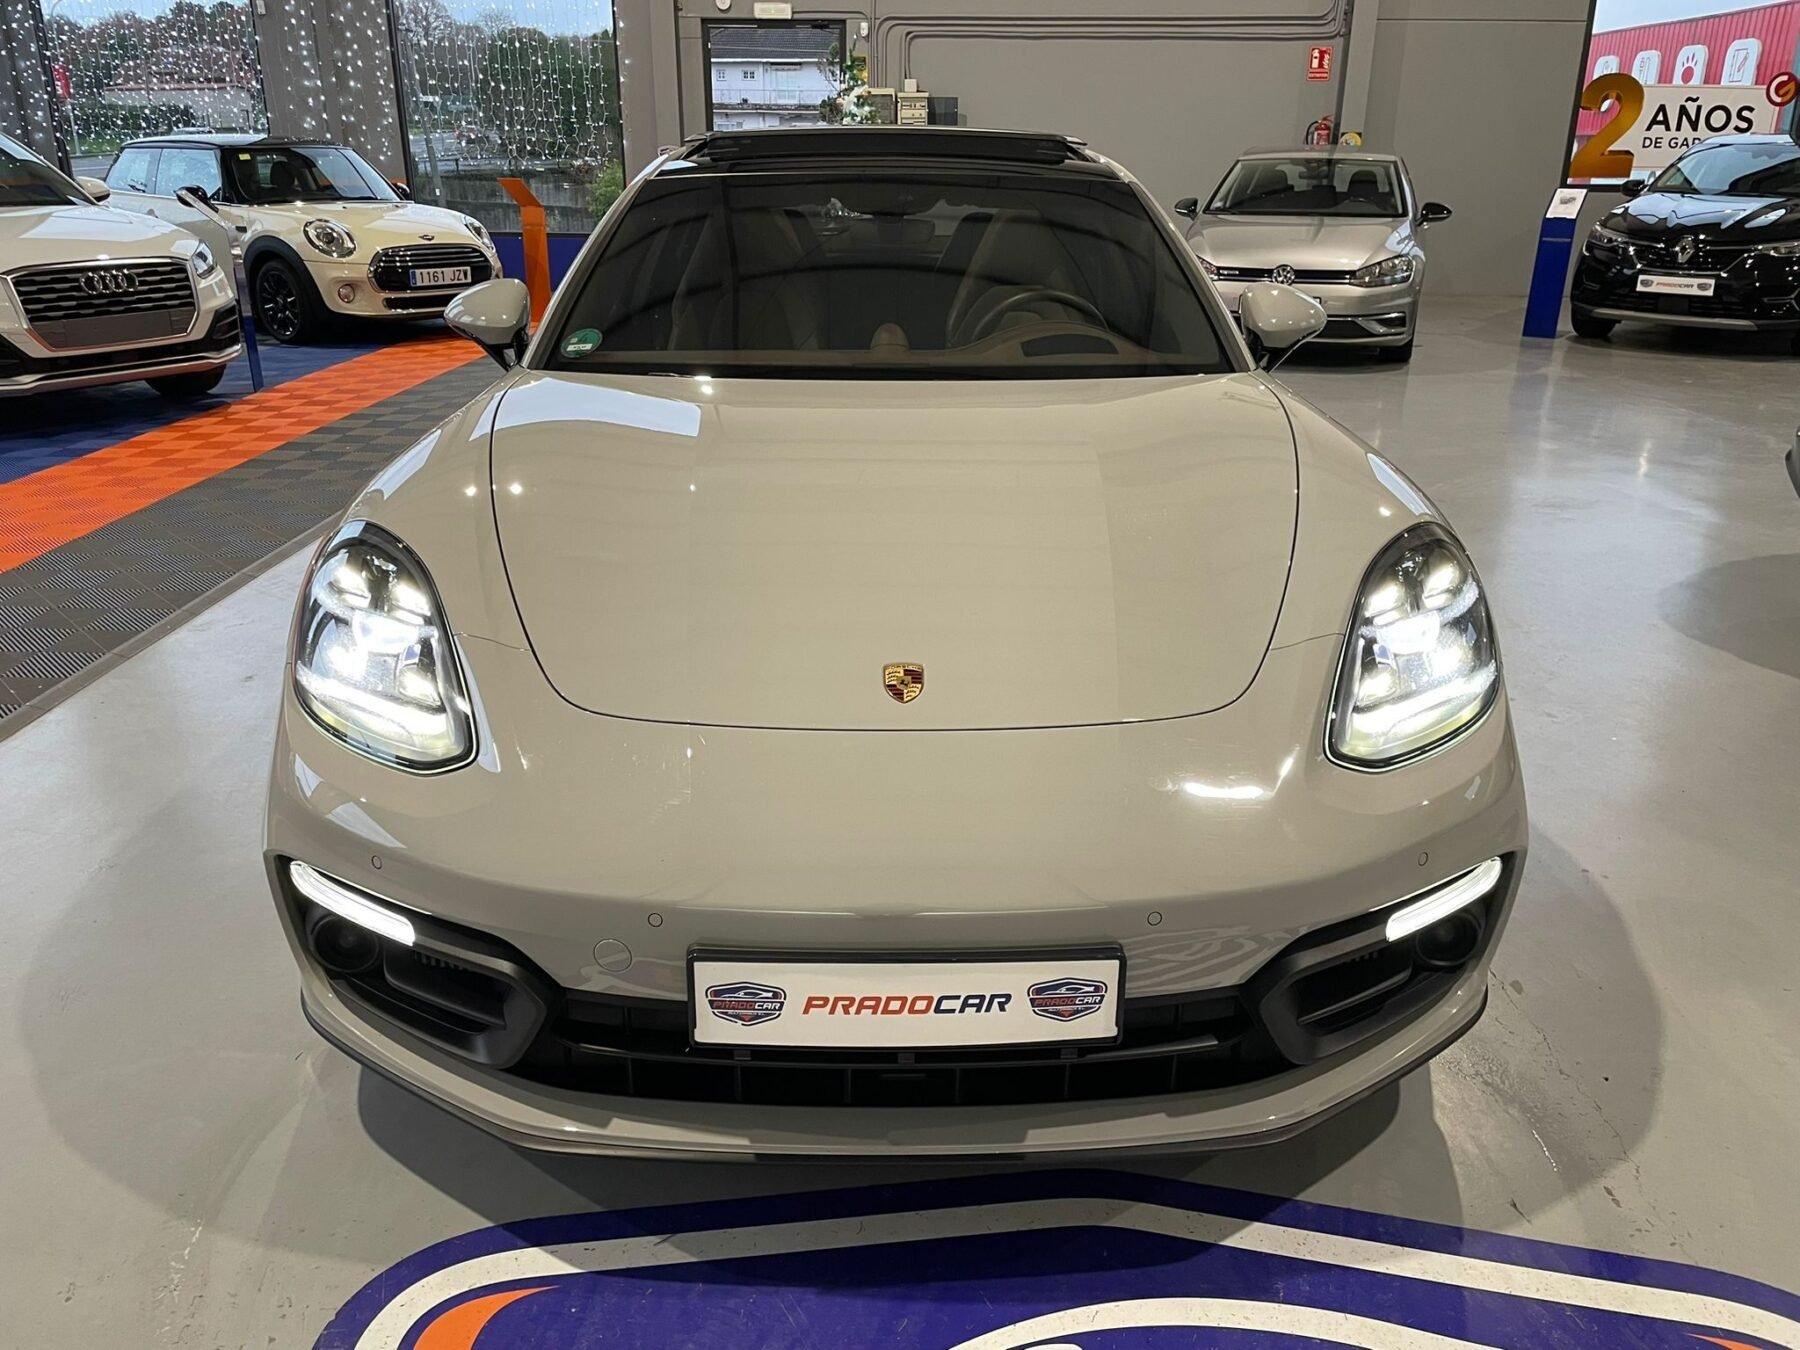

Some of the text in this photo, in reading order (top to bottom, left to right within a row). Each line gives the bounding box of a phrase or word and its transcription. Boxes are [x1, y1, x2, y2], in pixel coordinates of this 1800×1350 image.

[1568, 73, 1756, 178] 2 AÑOS
[1642, 137, 1663, 149] DE
[420, 270, 446, 283] 1161
[712, 1000, 781, 1011] PRADOCAR
[802, 993, 1012, 1016] PRADOCAR
[1033, 996, 1102, 1008] PRADOCAR
